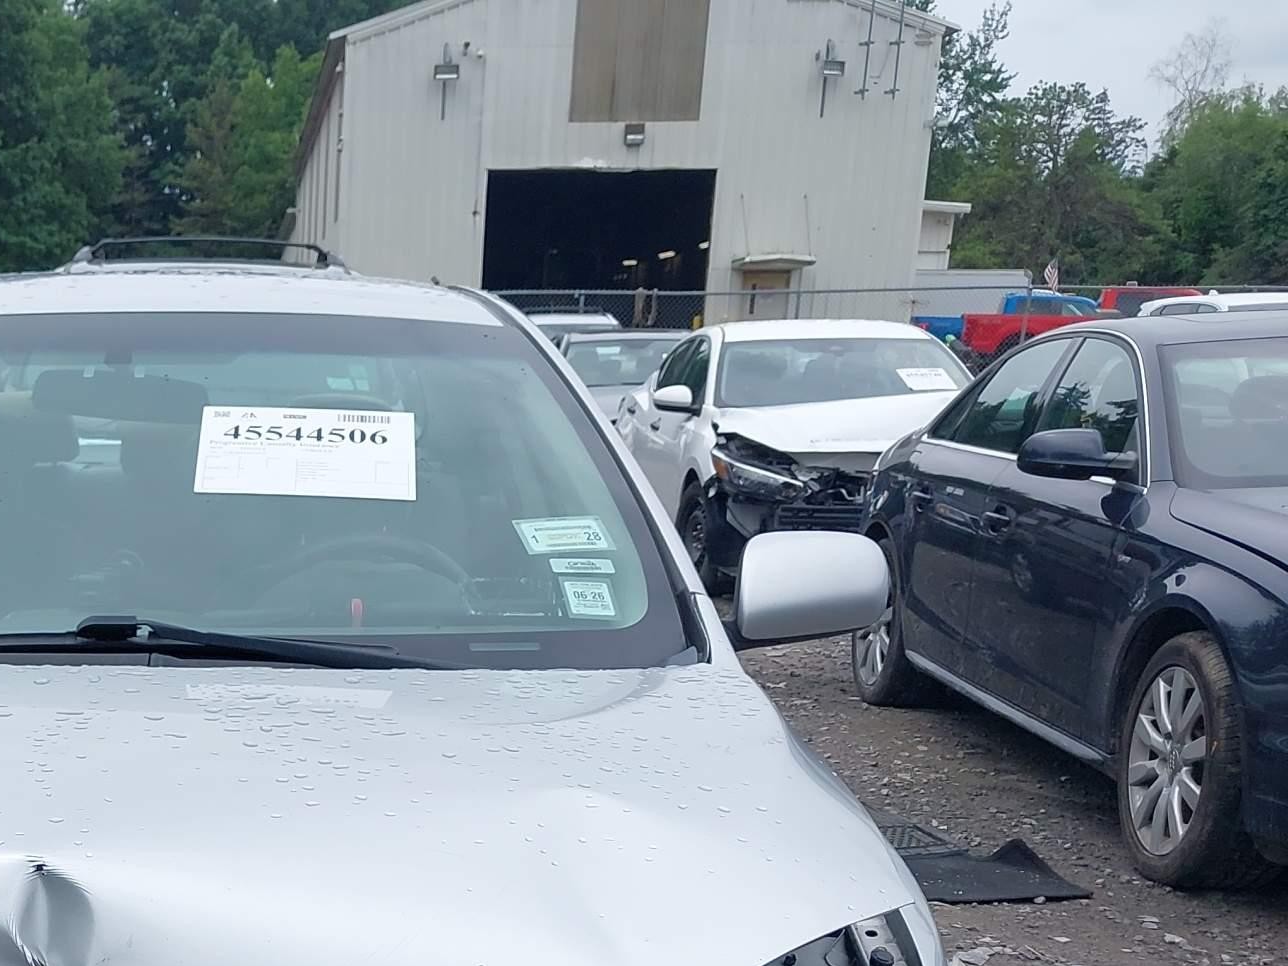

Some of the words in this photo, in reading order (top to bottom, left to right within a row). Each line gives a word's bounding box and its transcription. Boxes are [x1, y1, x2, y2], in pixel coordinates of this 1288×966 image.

[223, 424, 388, 445] 45544506
[583, 531, 602, 541] 28
[573, 591, 588, 599] 06
[590, 591, 605, 600] 26
